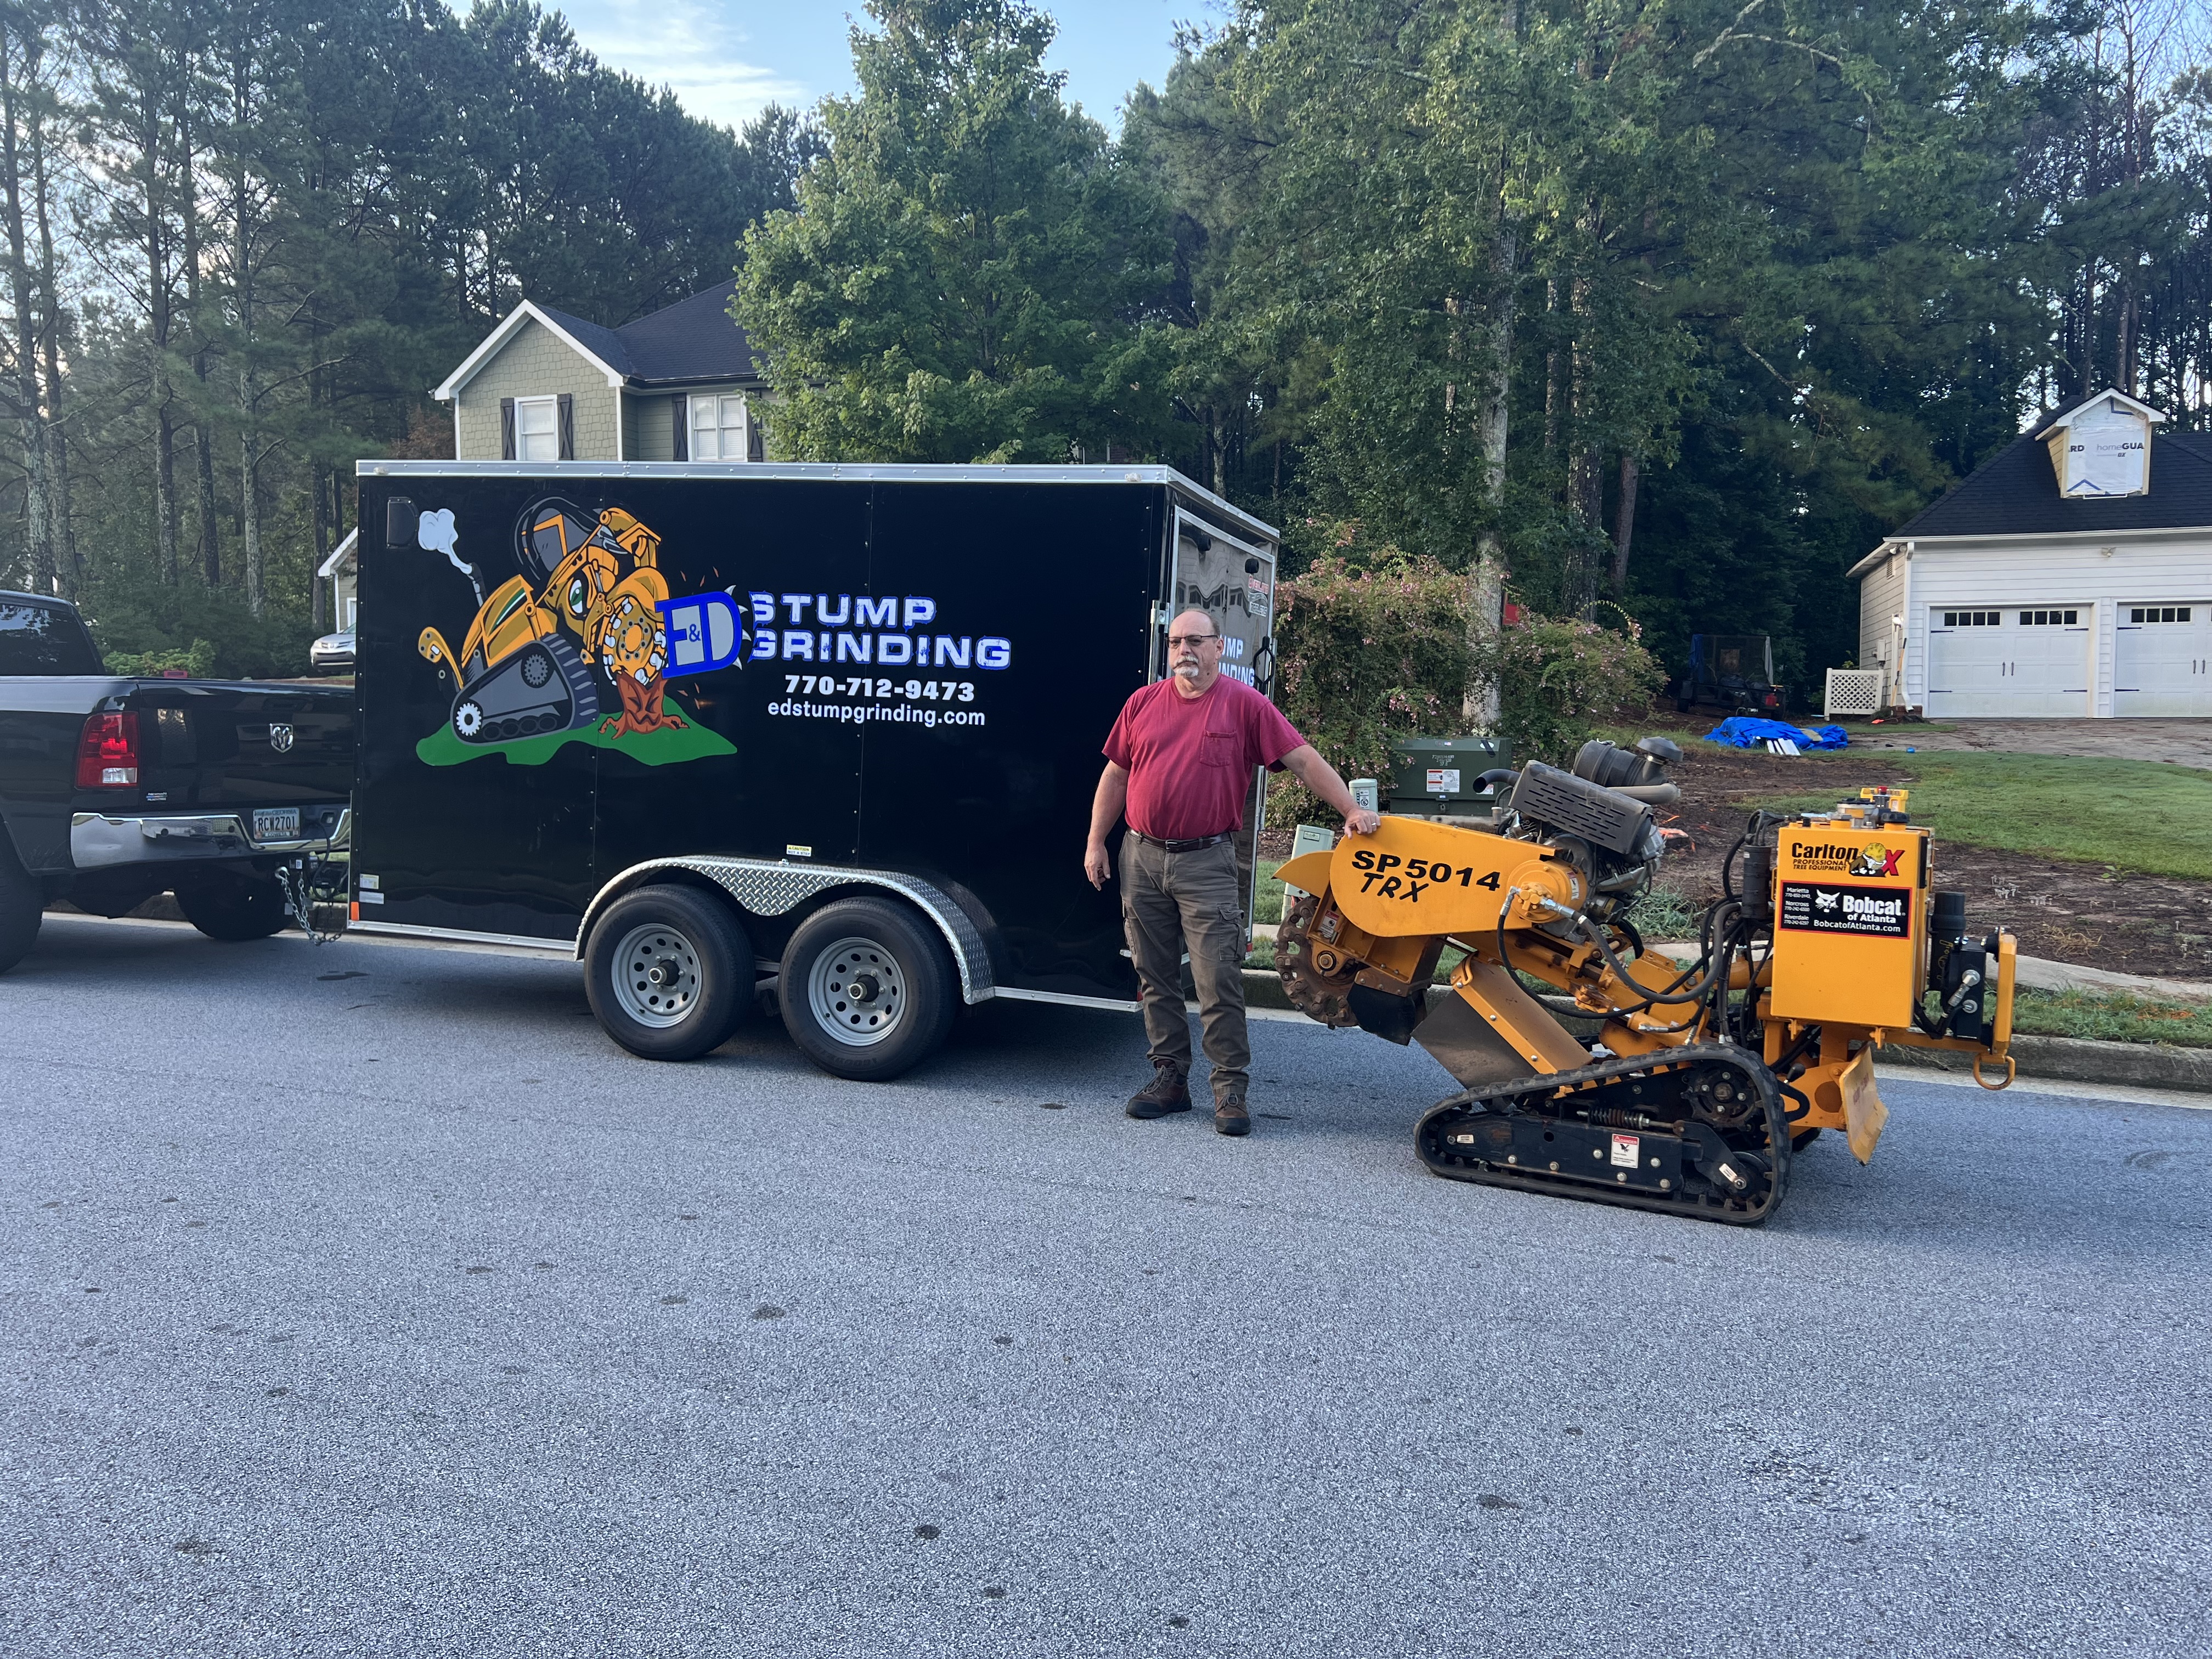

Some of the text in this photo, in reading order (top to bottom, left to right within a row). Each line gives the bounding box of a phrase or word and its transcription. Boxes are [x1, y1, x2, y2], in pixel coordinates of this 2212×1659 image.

[749, 591, 936, 631] STUMP
[655, 591, 742, 679] E&D
[748, 629, 1011, 669] GRINDING
[1219, 634, 1244, 659] UMP
[785, 674, 974, 702] 770-712-9473
[768, 698, 986, 727] edstumpgrinding.com
[258, 816, 295, 831] RCW2701
[1792, 843, 1859, 860] Carlton
[1352, 850, 1501, 892] SP5014
[1361, 872, 1429, 903] TRX
[1842, 895, 1902, 916] Bobcat
[1860, 913, 1896, 923] Atlanta
[1814, 919, 1901, 932] BobcatofAtlanta.com
